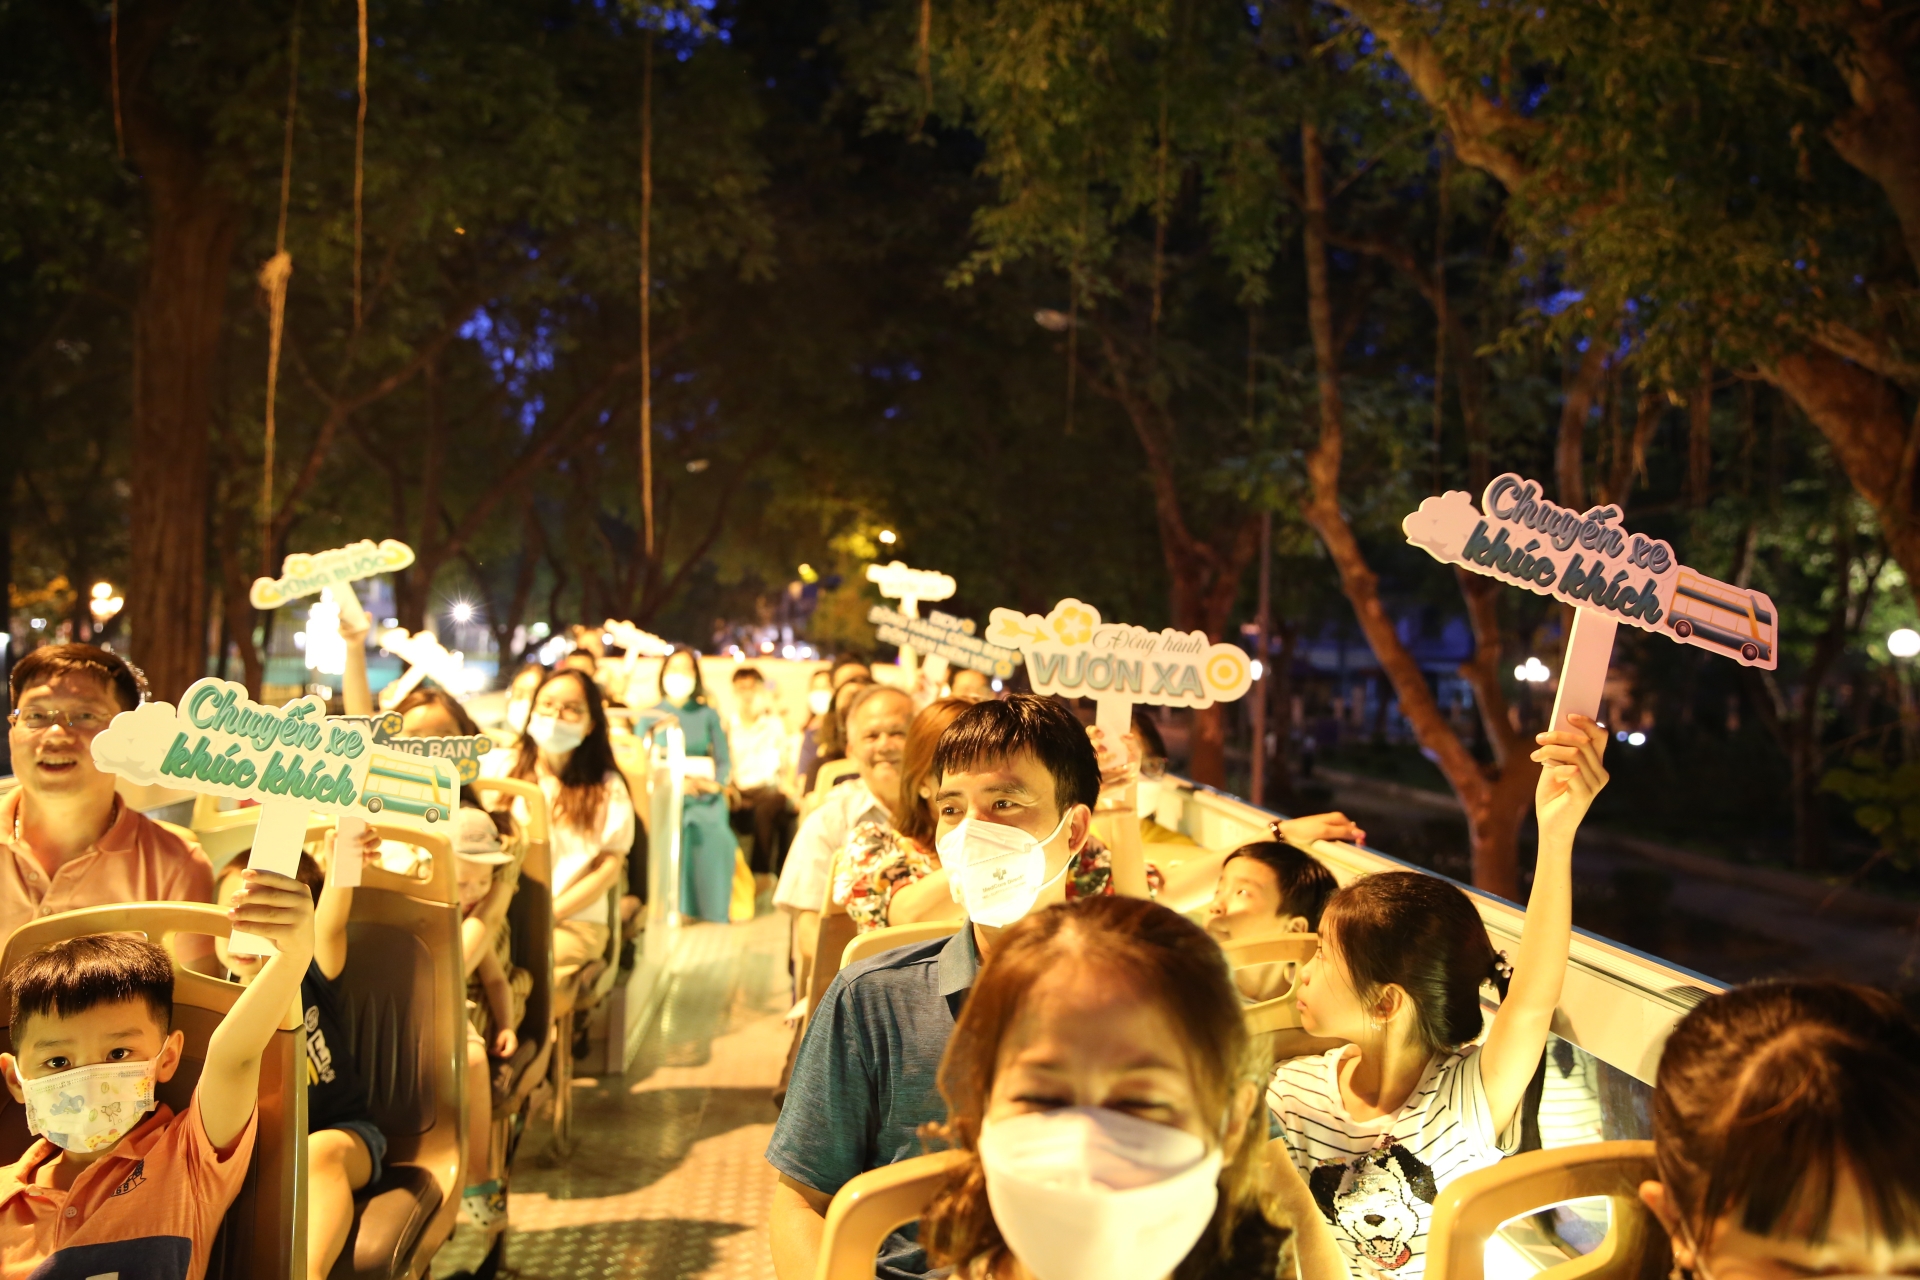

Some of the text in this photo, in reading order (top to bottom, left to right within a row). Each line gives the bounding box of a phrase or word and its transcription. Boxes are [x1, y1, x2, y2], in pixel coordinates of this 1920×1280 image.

[1487, 476, 1672, 574] Chuyến xe
[1462, 519, 1663, 625] khúc khích
[1032, 650, 1205, 698] VƯƠN XA
[1092, 629, 1202, 655] Đồng hành
[188, 684, 365, 759] Chuyến xe
[160, 732, 358, 807] khúc khích
